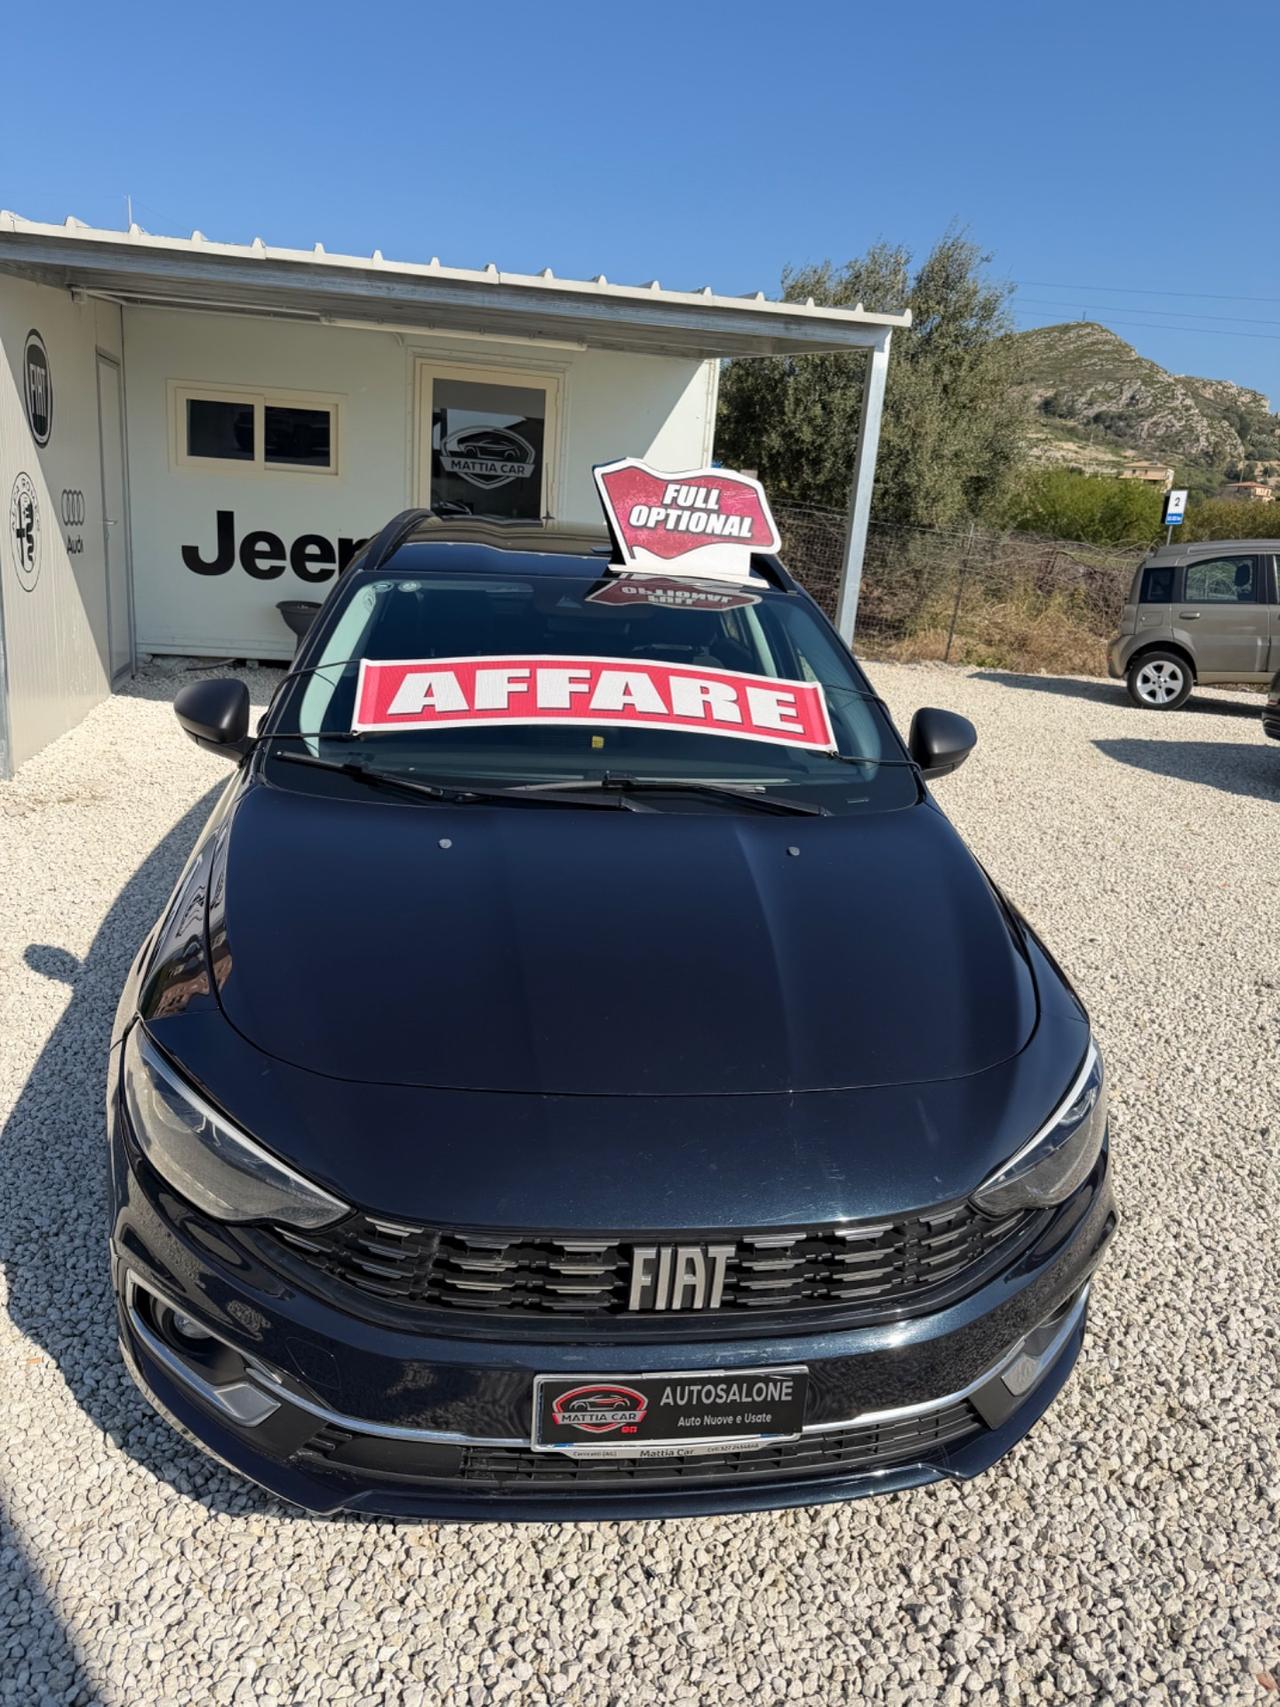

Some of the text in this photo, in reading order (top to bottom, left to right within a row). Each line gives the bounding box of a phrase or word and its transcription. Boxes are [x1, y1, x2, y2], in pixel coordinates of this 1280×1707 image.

[451, 458, 526, 476] MATTIA CAR
[663, 483, 721, 510] FULL
[1174, 496, 1181, 507] 2
[629, 505, 753, 538] OPTIONAL
[386, 668, 805, 734] AFFARE
[628, 1245, 736, 1310] FIAT
[660, 1381, 794, 1406] AUTOSALONE
[561, 1412, 637, 1422] MATTIA CAR
[677, 1413, 773, 1427] Auto Nuove e Usate
[639, 1448, 694, 1457] Mattia Car
